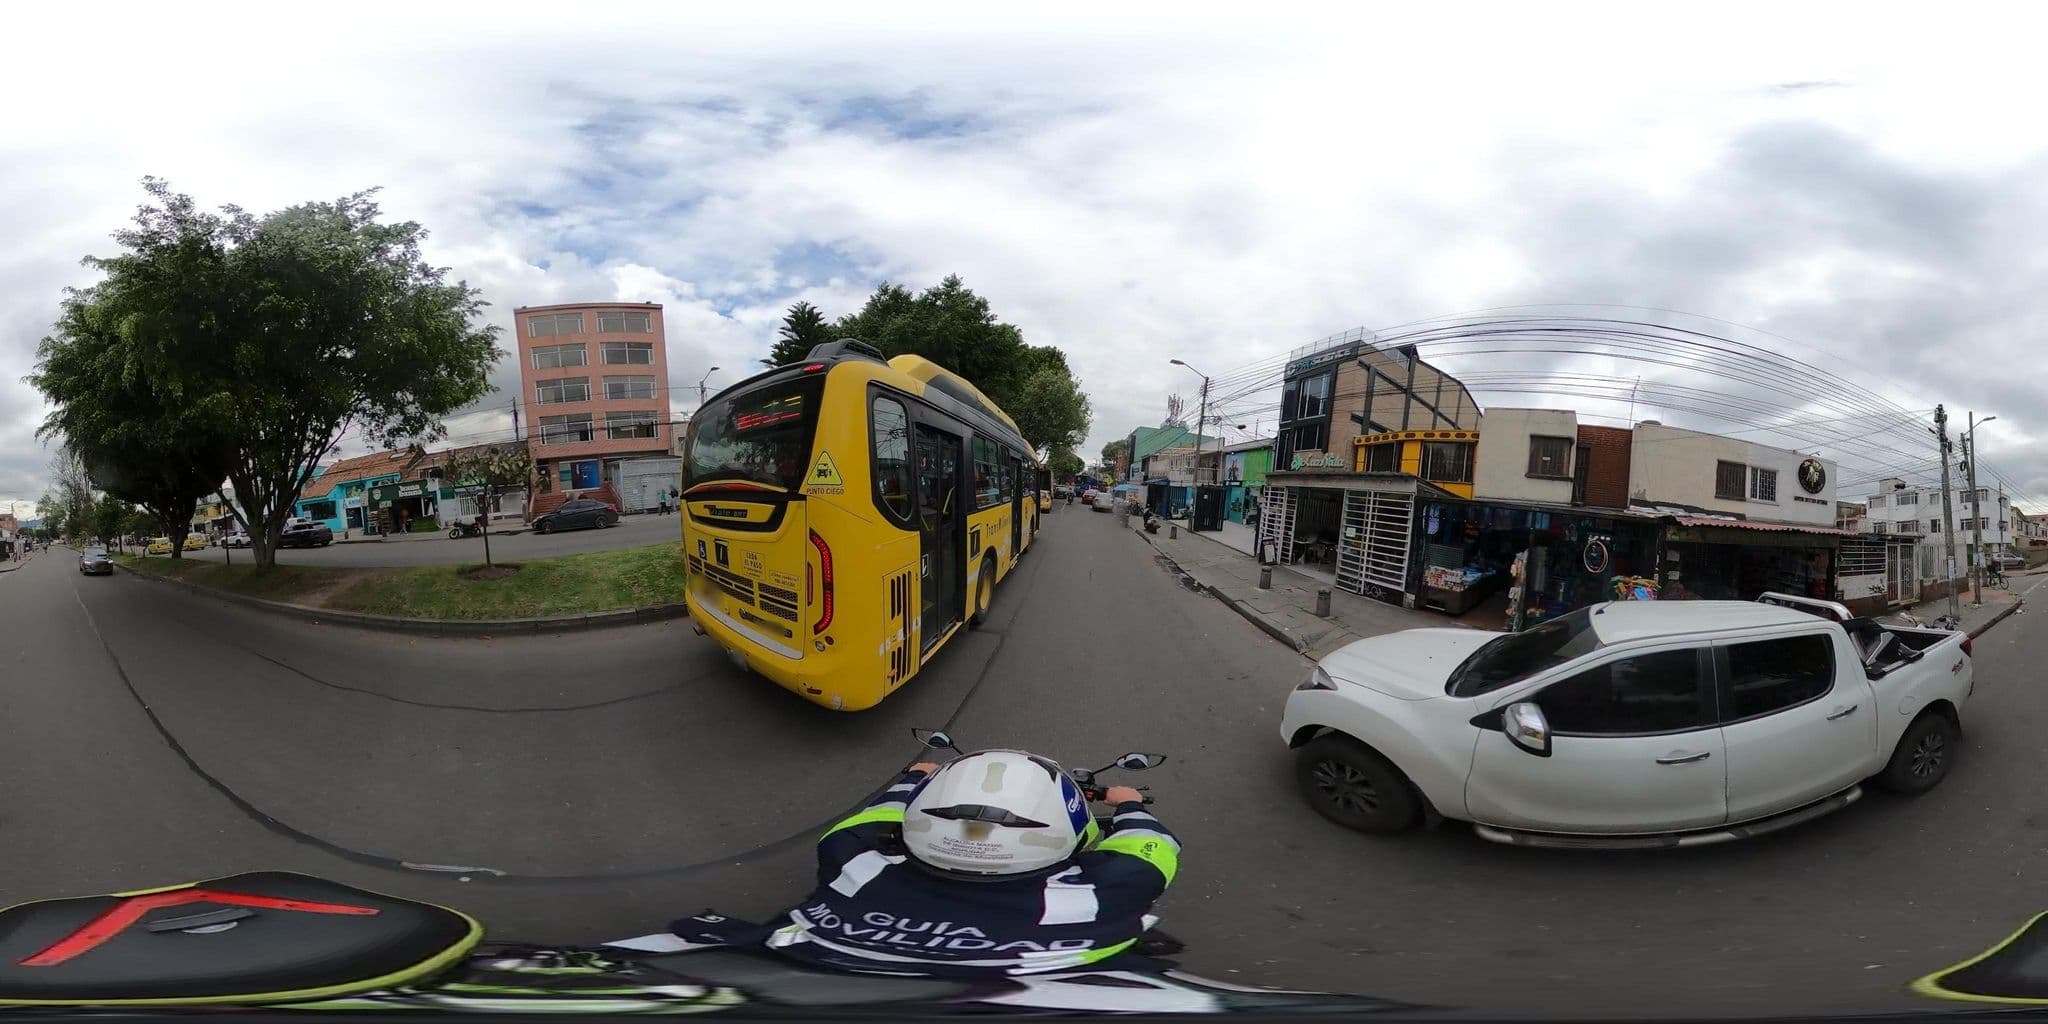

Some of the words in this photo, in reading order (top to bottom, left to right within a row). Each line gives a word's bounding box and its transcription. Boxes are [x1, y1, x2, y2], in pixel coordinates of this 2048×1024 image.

[807, 487, 825, 495] PUNTO
[826, 487, 844, 495] CIEGO
[750, 560, 763, 570] PASO
[807, 902, 1096, 951] MOVILIDAD
